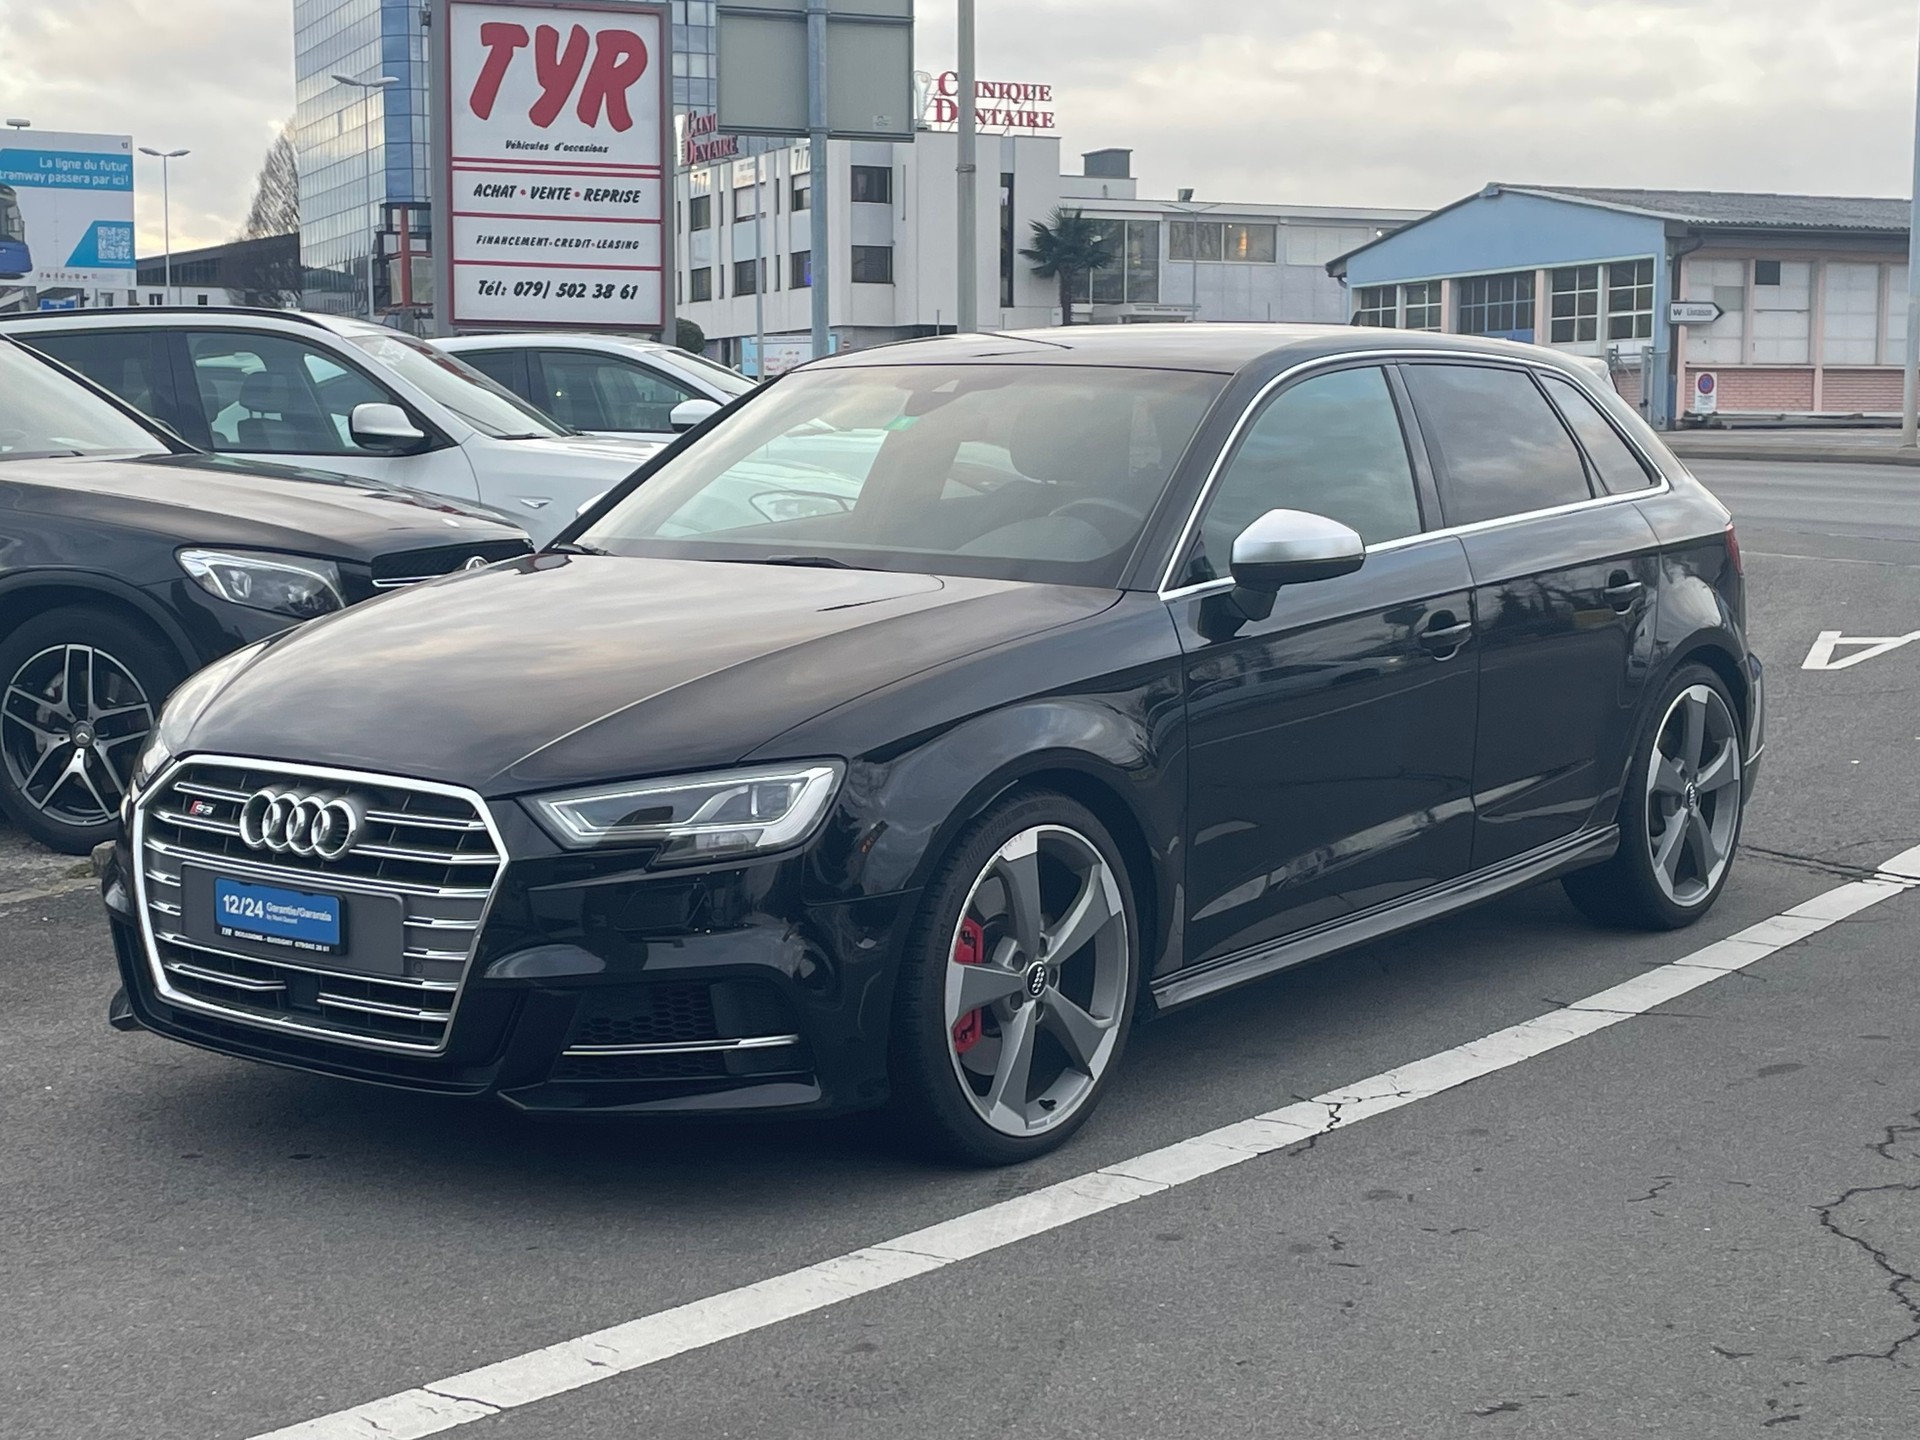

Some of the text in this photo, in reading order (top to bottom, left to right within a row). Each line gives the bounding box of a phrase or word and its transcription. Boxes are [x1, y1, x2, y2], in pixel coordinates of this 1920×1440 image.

[470, 21, 648, 133] TYR
[938, 71, 1052, 104] CINIQUE
[933, 97, 1055, 128] DNTAIRE
[505, 139, 609, 153] Véhicules d'occasions
[40, 157, 129, 171] La ligne du futur
[0, 171, 46, 184] tramway
[48, 173, 90, 184] passera
[92, 175, 110, 185] par
[473, 183, 641, 203] ACHAT VENTE REPRISE
[478, 280, 507, 296] Tél:
[555, 283, 587, 298] 502
[592, 284, 615, 299] 38
[620, 284, 638, 300] 61
[223, 894, 264, 918] 12/24
